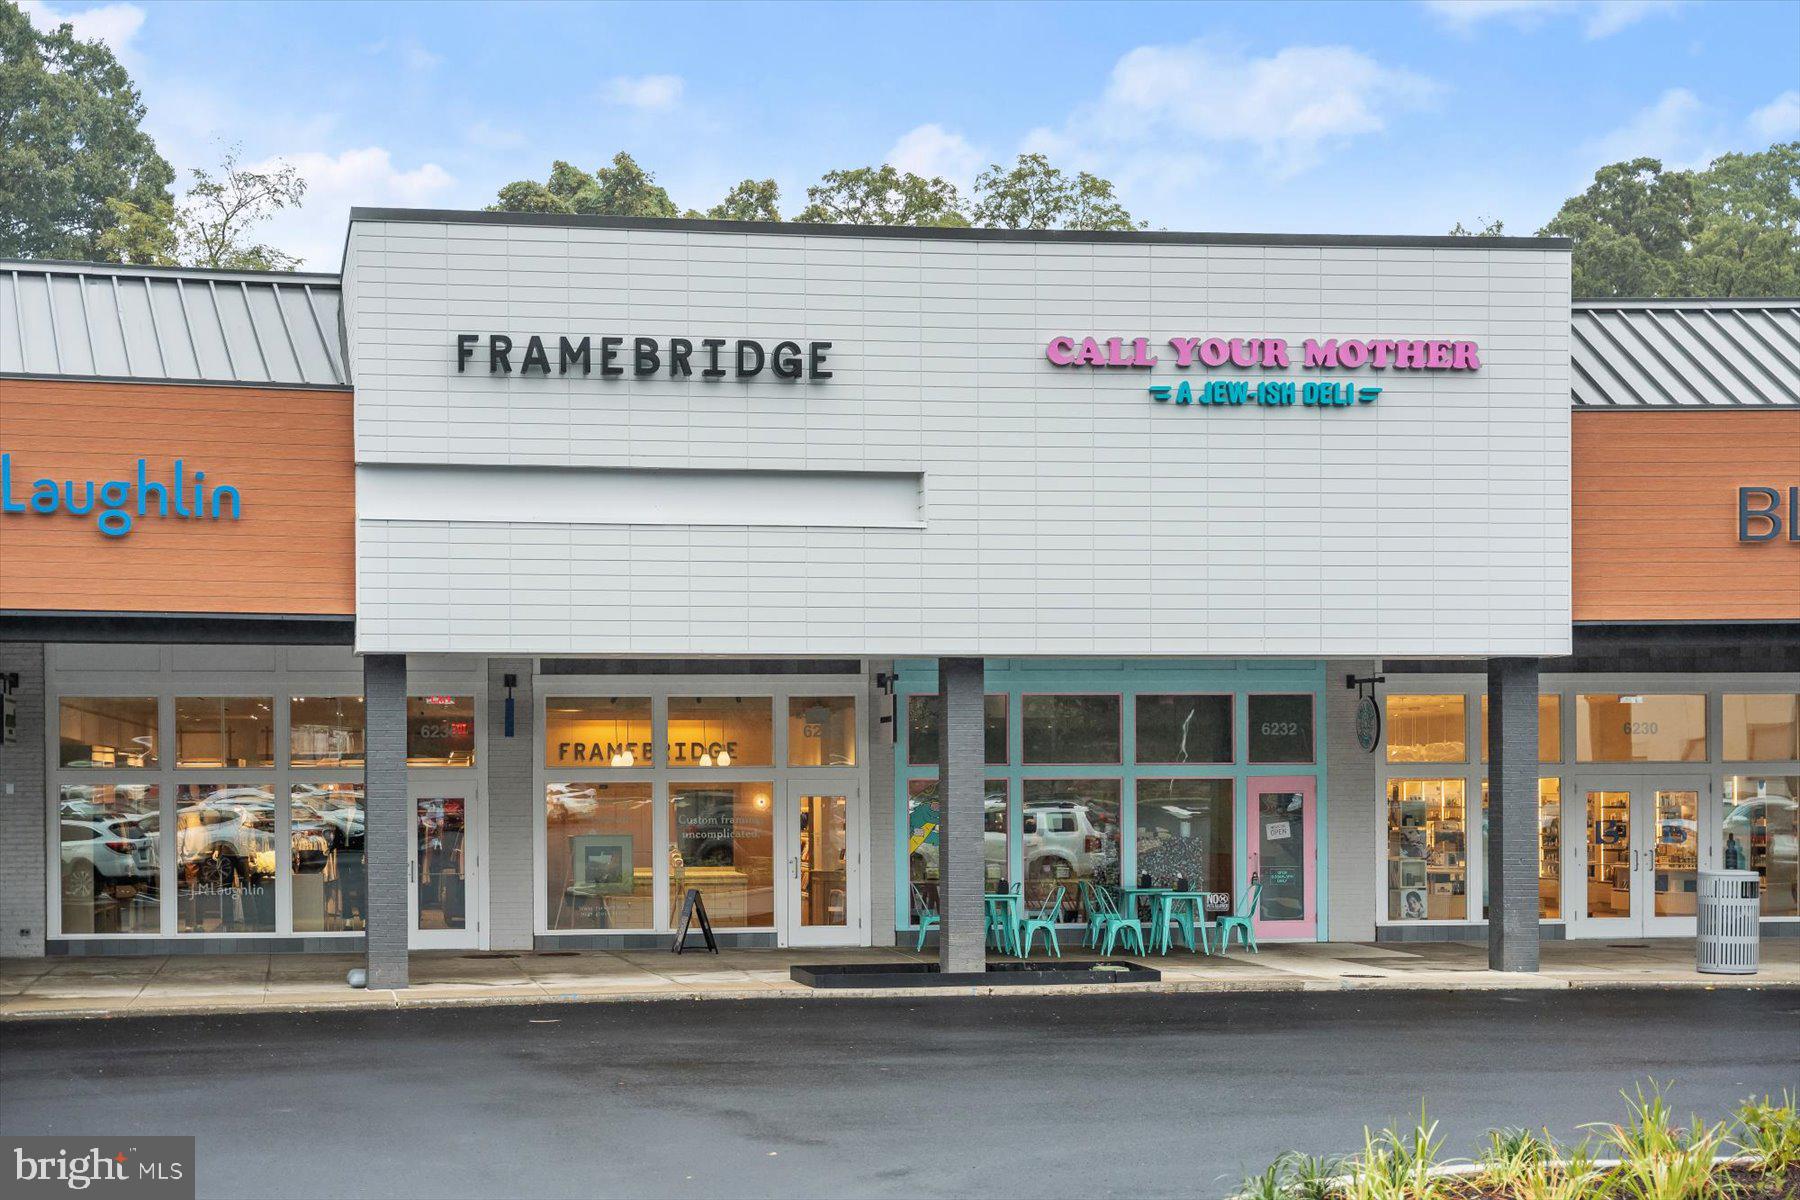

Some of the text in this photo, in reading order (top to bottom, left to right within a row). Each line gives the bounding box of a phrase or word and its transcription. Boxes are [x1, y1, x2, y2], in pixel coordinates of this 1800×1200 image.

[457, 334, 833, 379] FRAMEBRIDGE
[1046, 336, 1481, 370] CALL YOUR MOTHER
[1175, 380, 1355, 406] A JEW-ISH DELI
[1, 453, 241, 536] Laughlin
[420, 725, 459, 738] 623
[1261, 722, 1298, 735] 6232
[1623, 722, 1658, 735] 6230
[558, 742, 738, 761] FRAMEBIDGE
[678, 814, 718, 825] Custom
